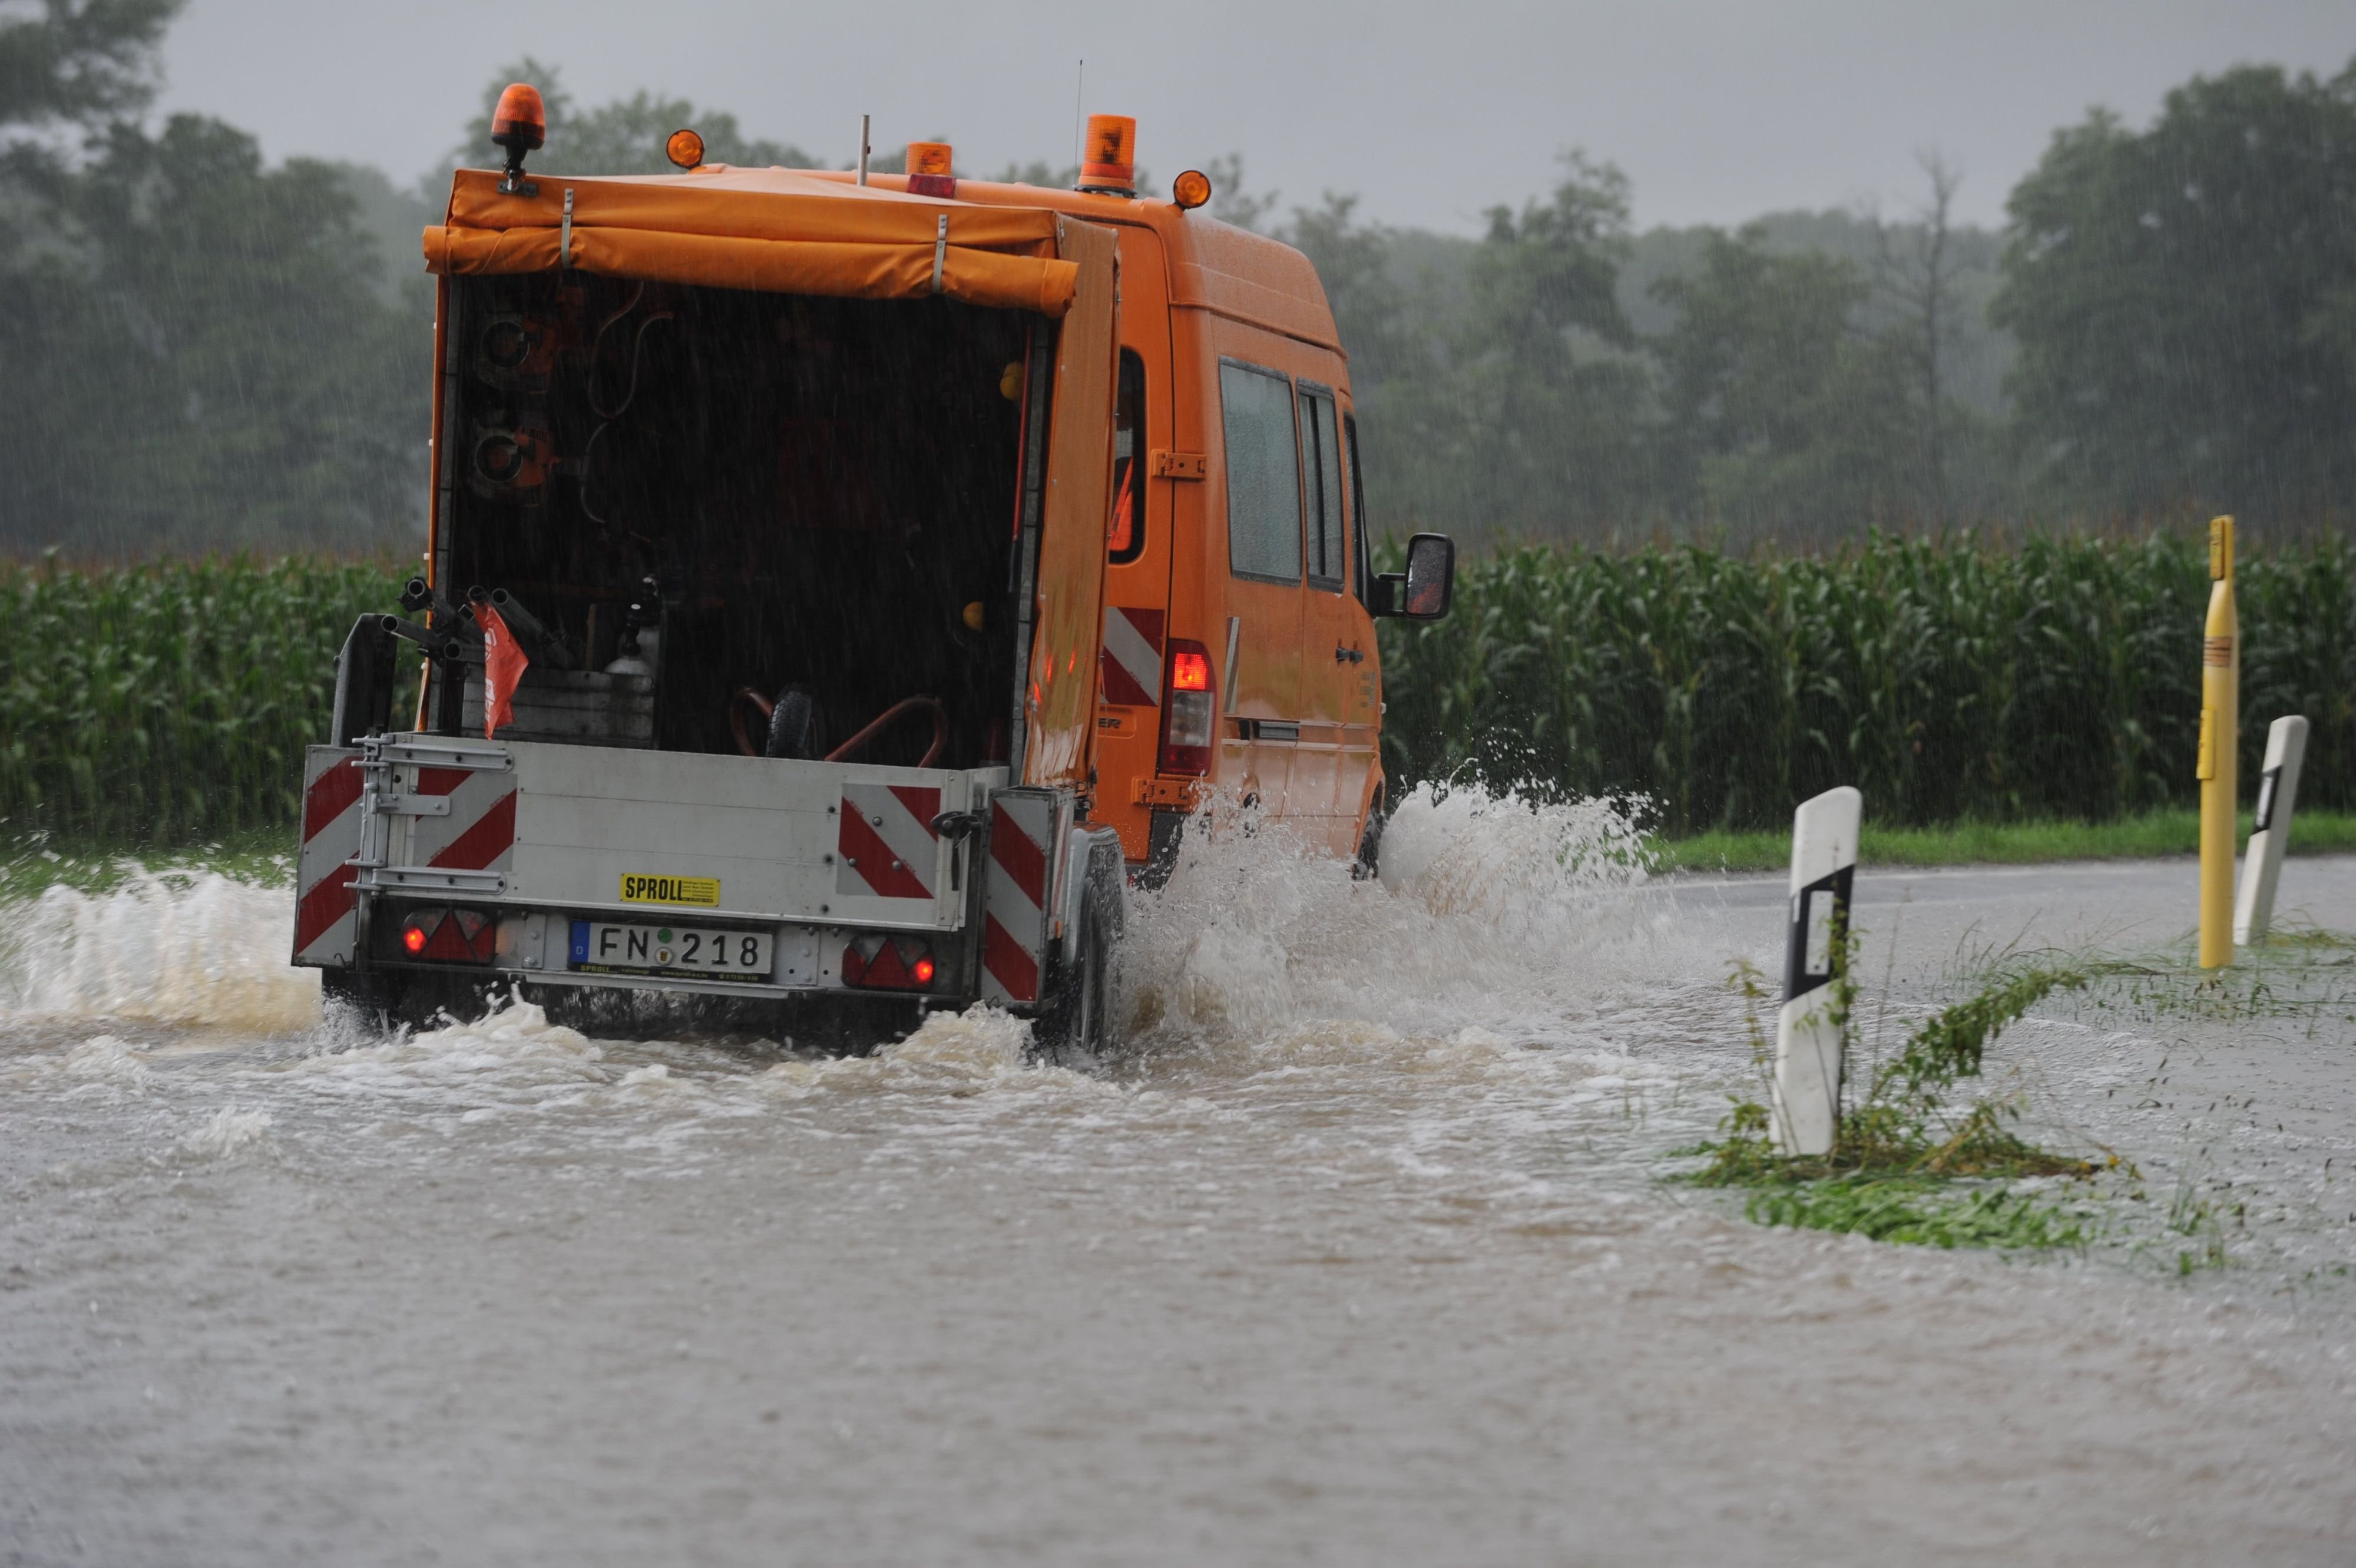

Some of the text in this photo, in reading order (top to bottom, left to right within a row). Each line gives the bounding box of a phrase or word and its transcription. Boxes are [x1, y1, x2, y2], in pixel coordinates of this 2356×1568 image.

[626, 876, 682, 901] SPROLL
[575, 946, 584, 955] D
[600, 928, 759, 967] FN 218
